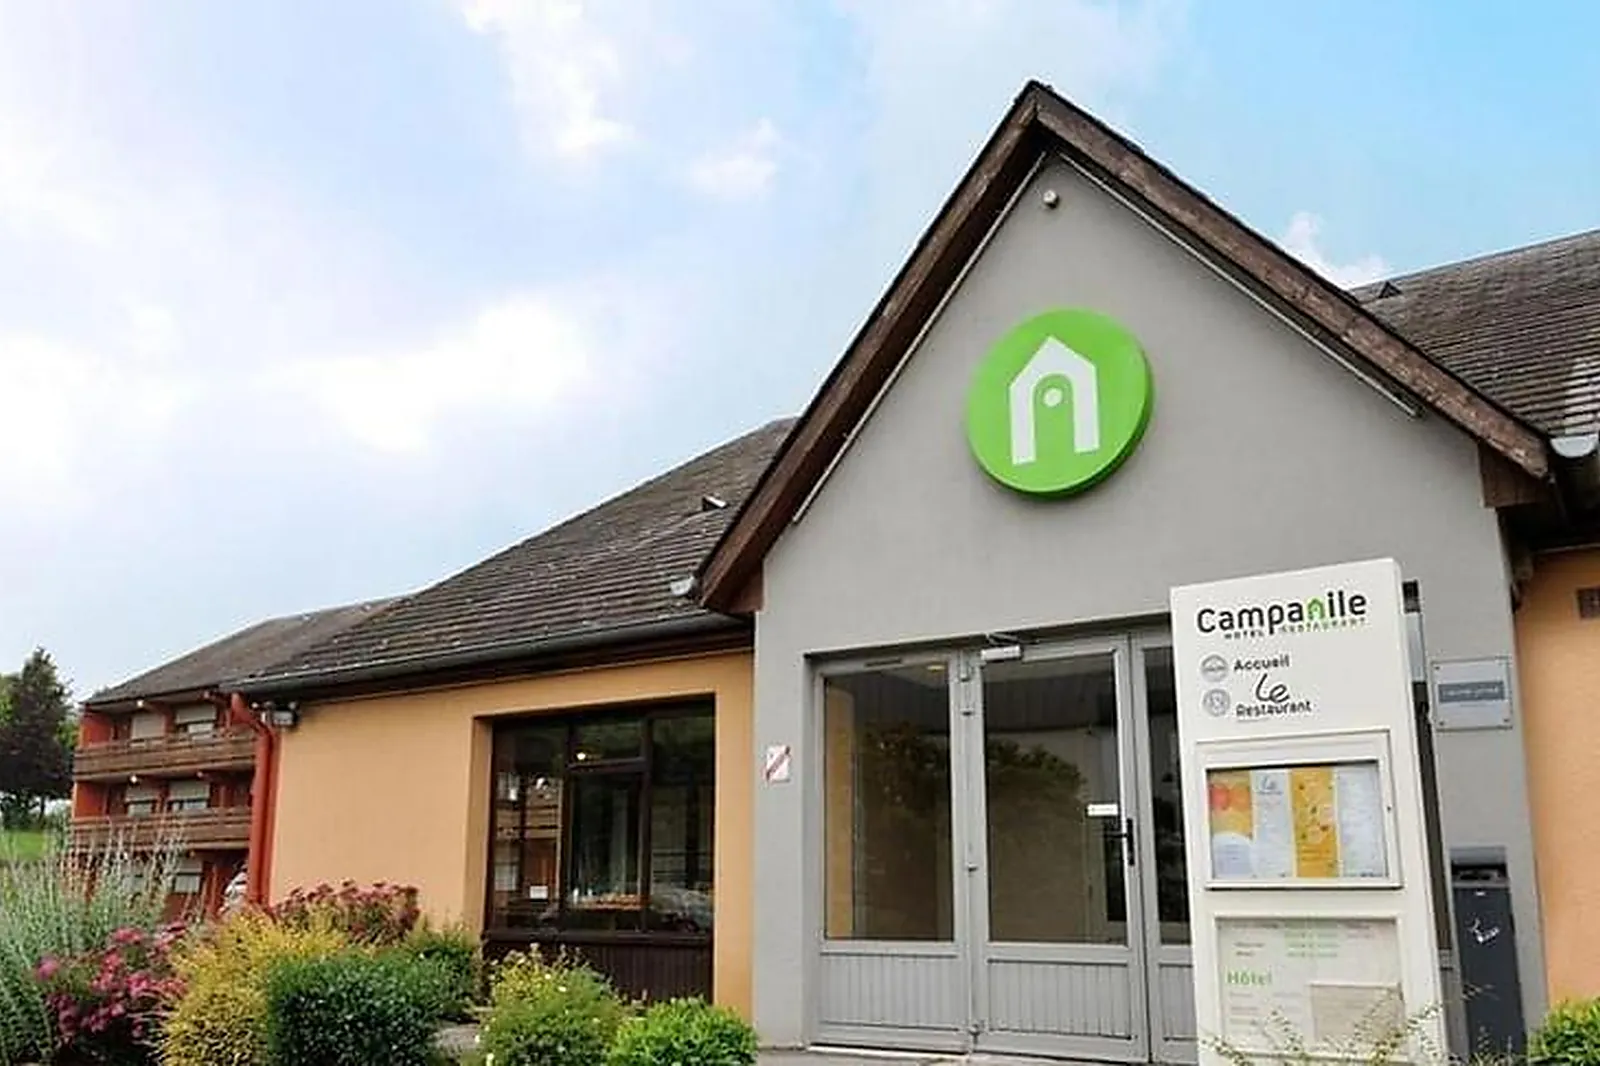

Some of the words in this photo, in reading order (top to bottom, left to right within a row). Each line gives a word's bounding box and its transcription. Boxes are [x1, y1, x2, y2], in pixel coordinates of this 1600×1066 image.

[1197, 590, 1367, 636] Campanile
[1234, 654, 1290, 671] Accueil
[1255, 672, 1291, 703] Le
[1236, 700, 1312, 717] Restaurant
[1227, 969, 1273, 987] Hôtel
